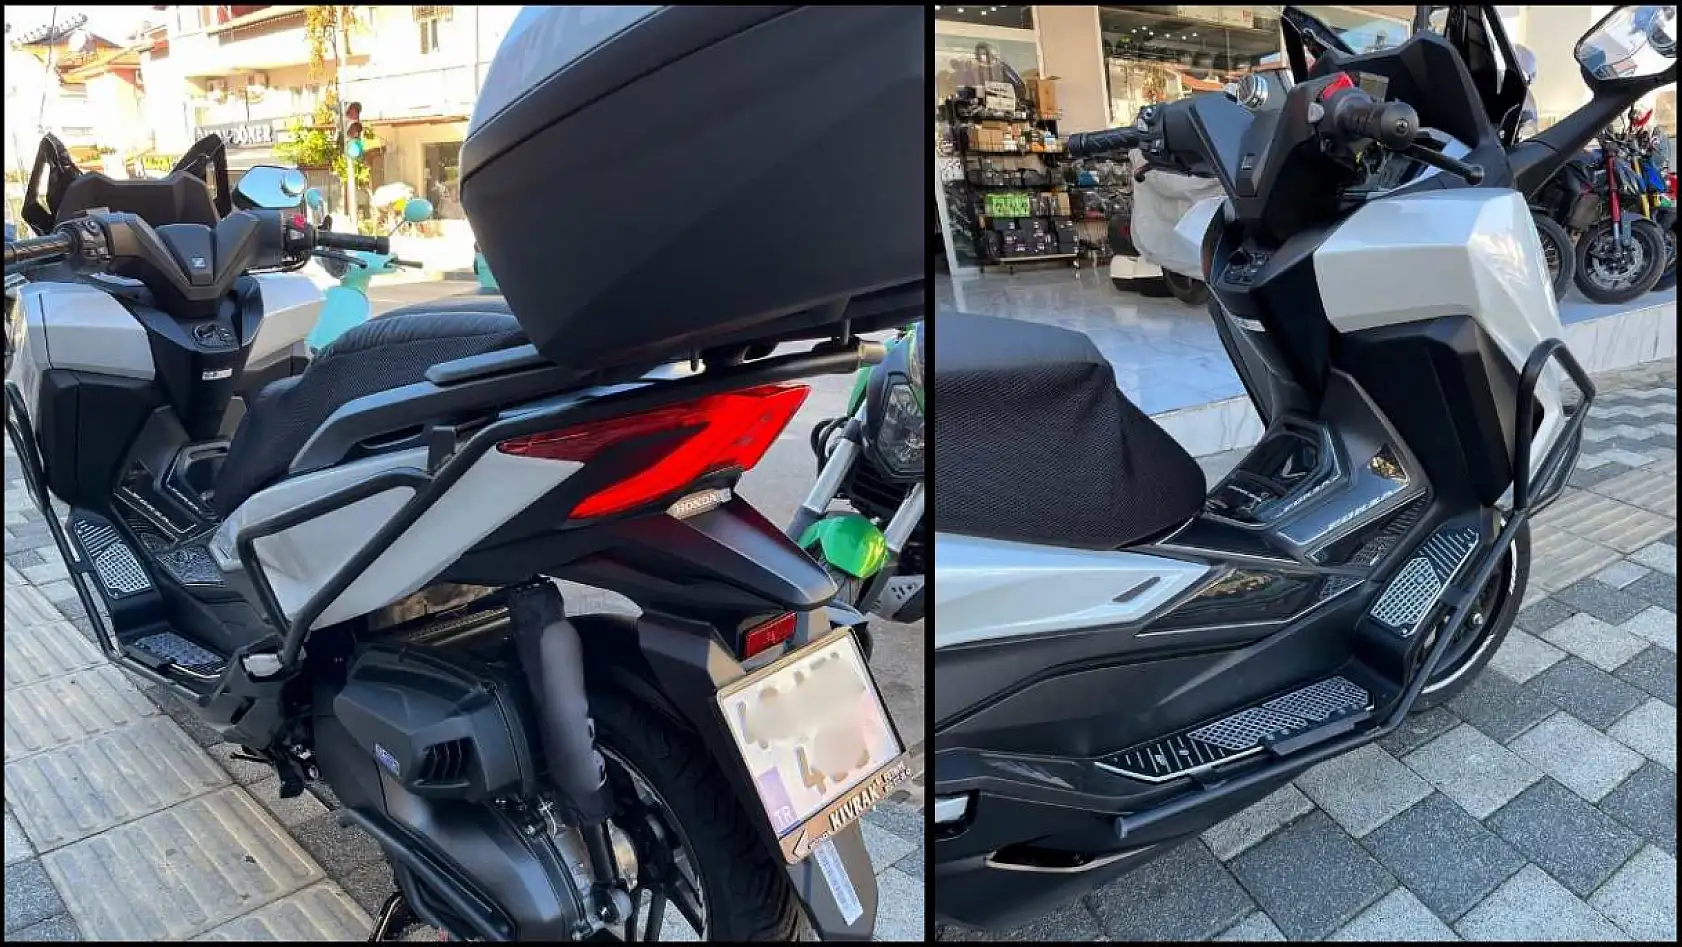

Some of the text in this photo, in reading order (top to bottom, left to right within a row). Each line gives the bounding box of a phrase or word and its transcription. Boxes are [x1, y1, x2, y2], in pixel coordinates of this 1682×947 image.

[673, 492, 716, 514] HONDA
[829, 777, 881, 832] KIVRAK
[774, 805, 793, 828] TR
